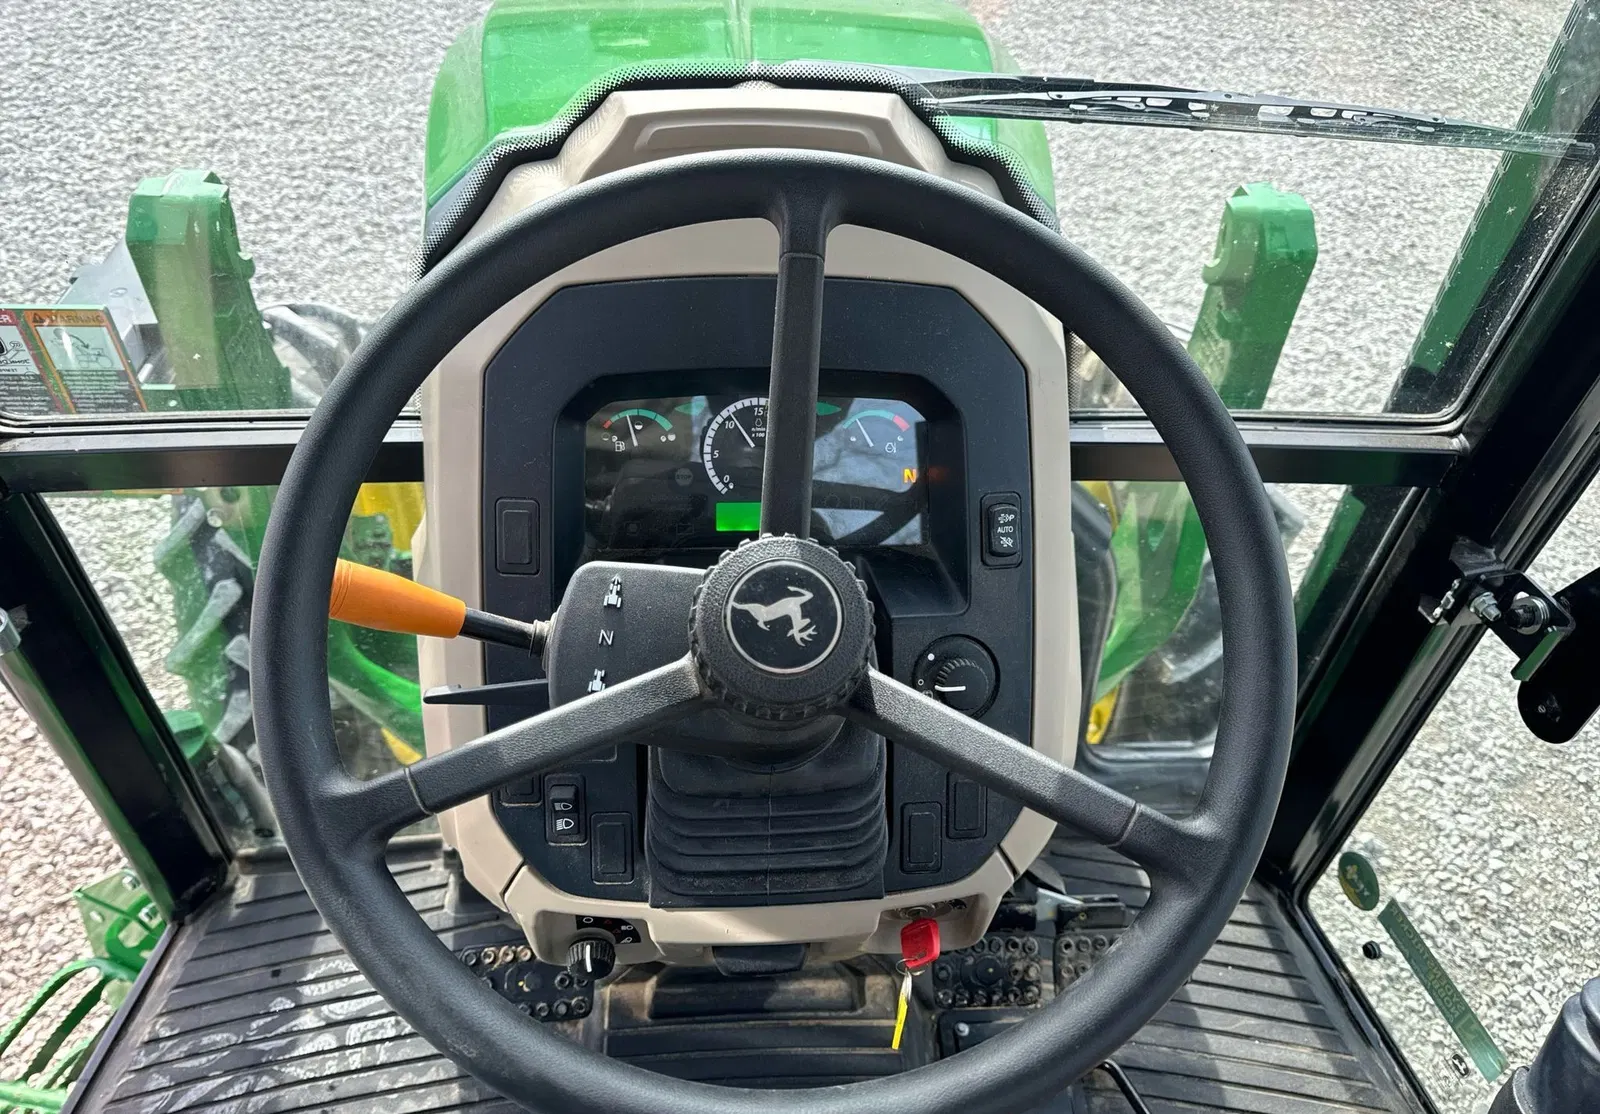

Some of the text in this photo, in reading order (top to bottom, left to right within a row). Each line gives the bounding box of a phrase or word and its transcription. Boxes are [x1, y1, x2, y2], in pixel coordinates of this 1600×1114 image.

[46, 314, 105, 324] WARNING
[753, 407, 764, 416] 15
[724, 420, 735, 429] 10
[712, 449, 720, 459] 5
[723, 474, 730, 483] 0
[903, 468, 917, 483] N
[996, 525, 1014, 534] AUTO
[598, 629, 614, 645] N
